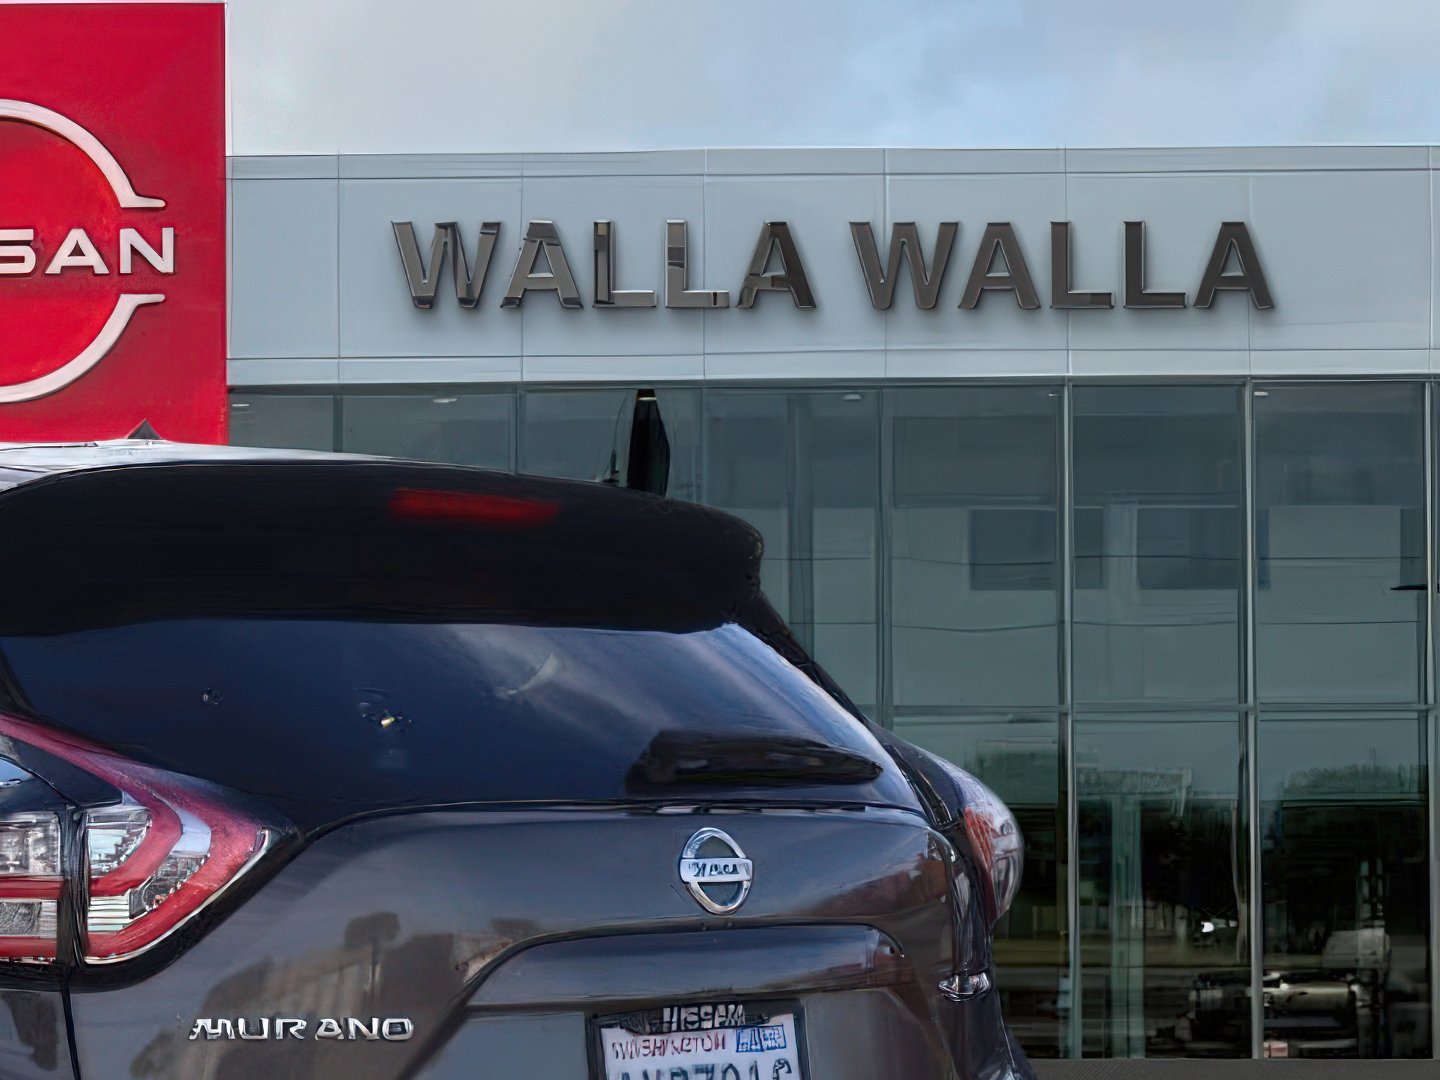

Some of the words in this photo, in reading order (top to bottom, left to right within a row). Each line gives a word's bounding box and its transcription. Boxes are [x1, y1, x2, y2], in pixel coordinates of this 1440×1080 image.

[390, 219, 817, 310] WALLA
[848, 220, 1276, 310] WALLA
[188, 1017, 415, 1041] MURANO
